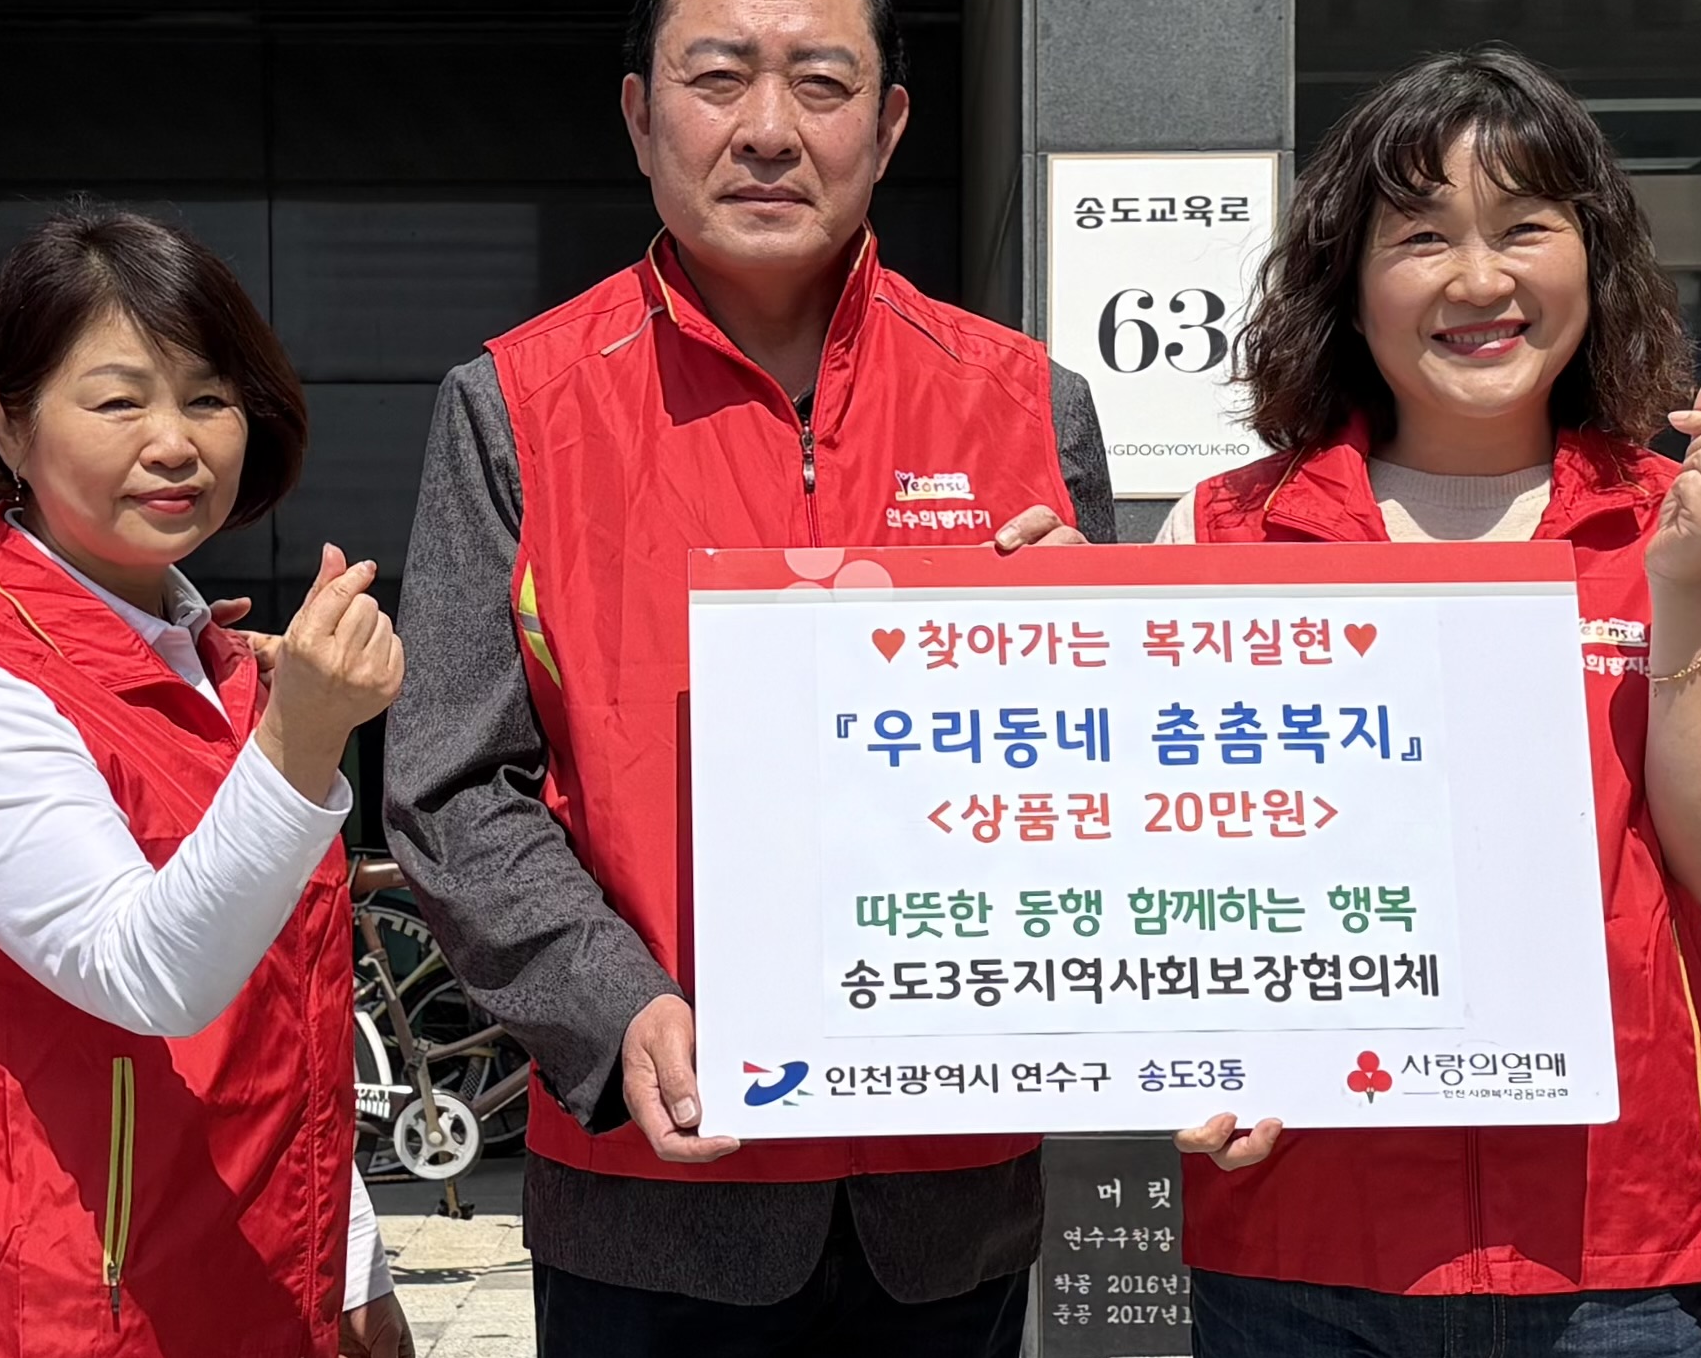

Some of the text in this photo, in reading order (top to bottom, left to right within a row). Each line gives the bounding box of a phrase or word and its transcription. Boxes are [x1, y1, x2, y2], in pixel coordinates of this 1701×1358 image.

[1074, 196, 1251, 229] 송도교육로
[1097, 288, 1229, 374] 63
[895, 471, 968, 496] Yeonsu
[918, 616, 1333, 670] 찾아가는 복지실현
[1579, 619, 1645, 641] eonsu
[927, 789, 1339, 844] <상품권 20만원>
[856, 884, 1417, 939] 따뜻한 동행 함께하는 행복
[840, 951, 1441, 1009] 송도3동지역사회보장협의체
[824, 1061, 1113, 1097] 인천광역시 연수구
[1137, 1058, 1247, 1092] 송도3동
[1401, 1053, 1567, 1086] 사랑의열매
[1063, 1226, 1176, 1252] 연수구청장
[1054, 1273, 1092, 1295] 착공
[1053, 1303, 1093, 1325] 준공
